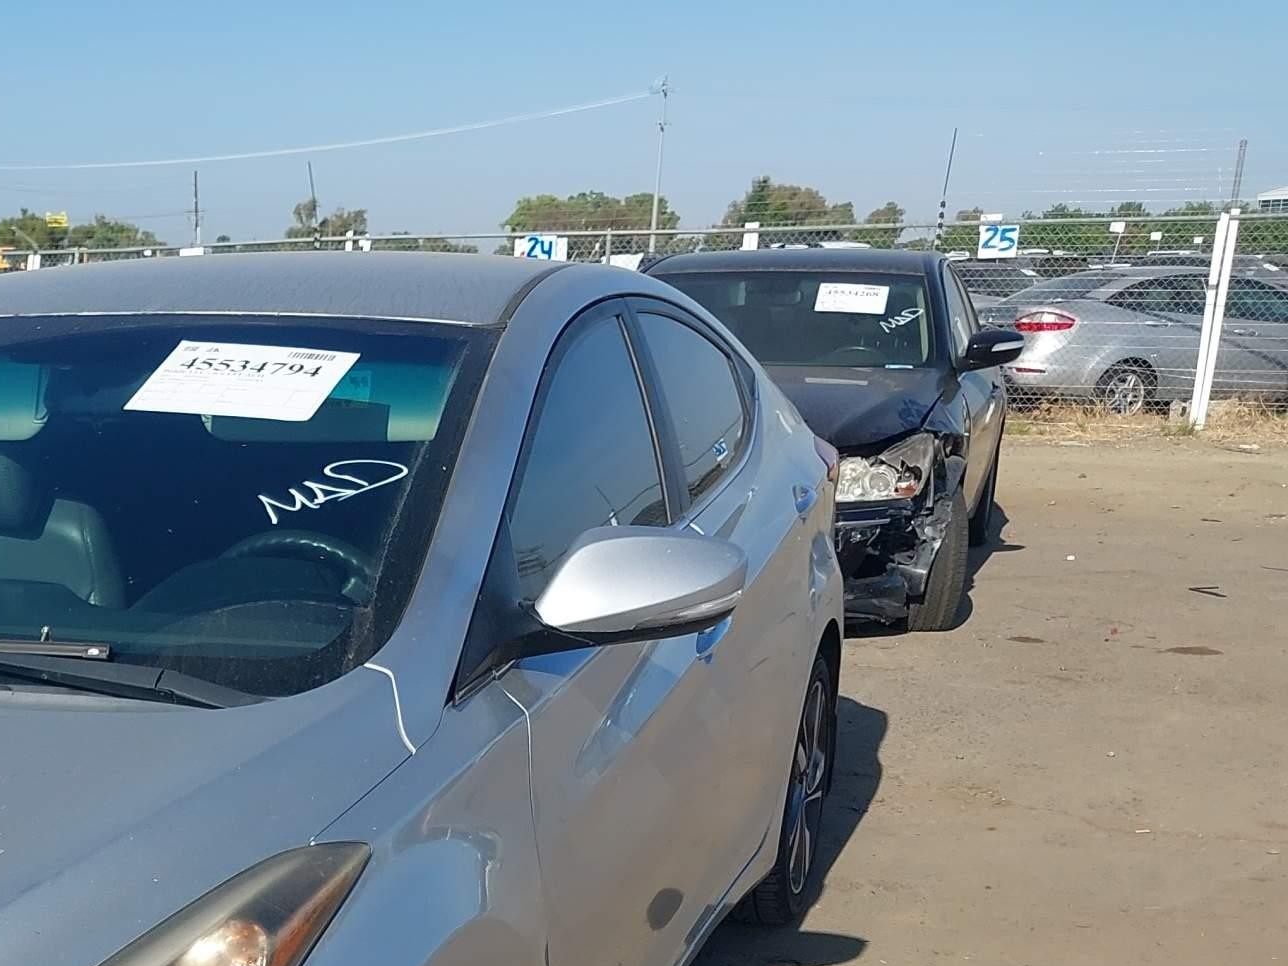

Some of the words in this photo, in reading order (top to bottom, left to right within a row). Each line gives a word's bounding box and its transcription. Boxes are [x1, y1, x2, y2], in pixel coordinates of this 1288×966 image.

[526, 236, 553, 260] 24
[981, 224, 1017, 252] 25
[879, 307, 925, 334] MAD
[179, 356, 323, 378] 45534794
[257, 459, 409, 525] MAD
